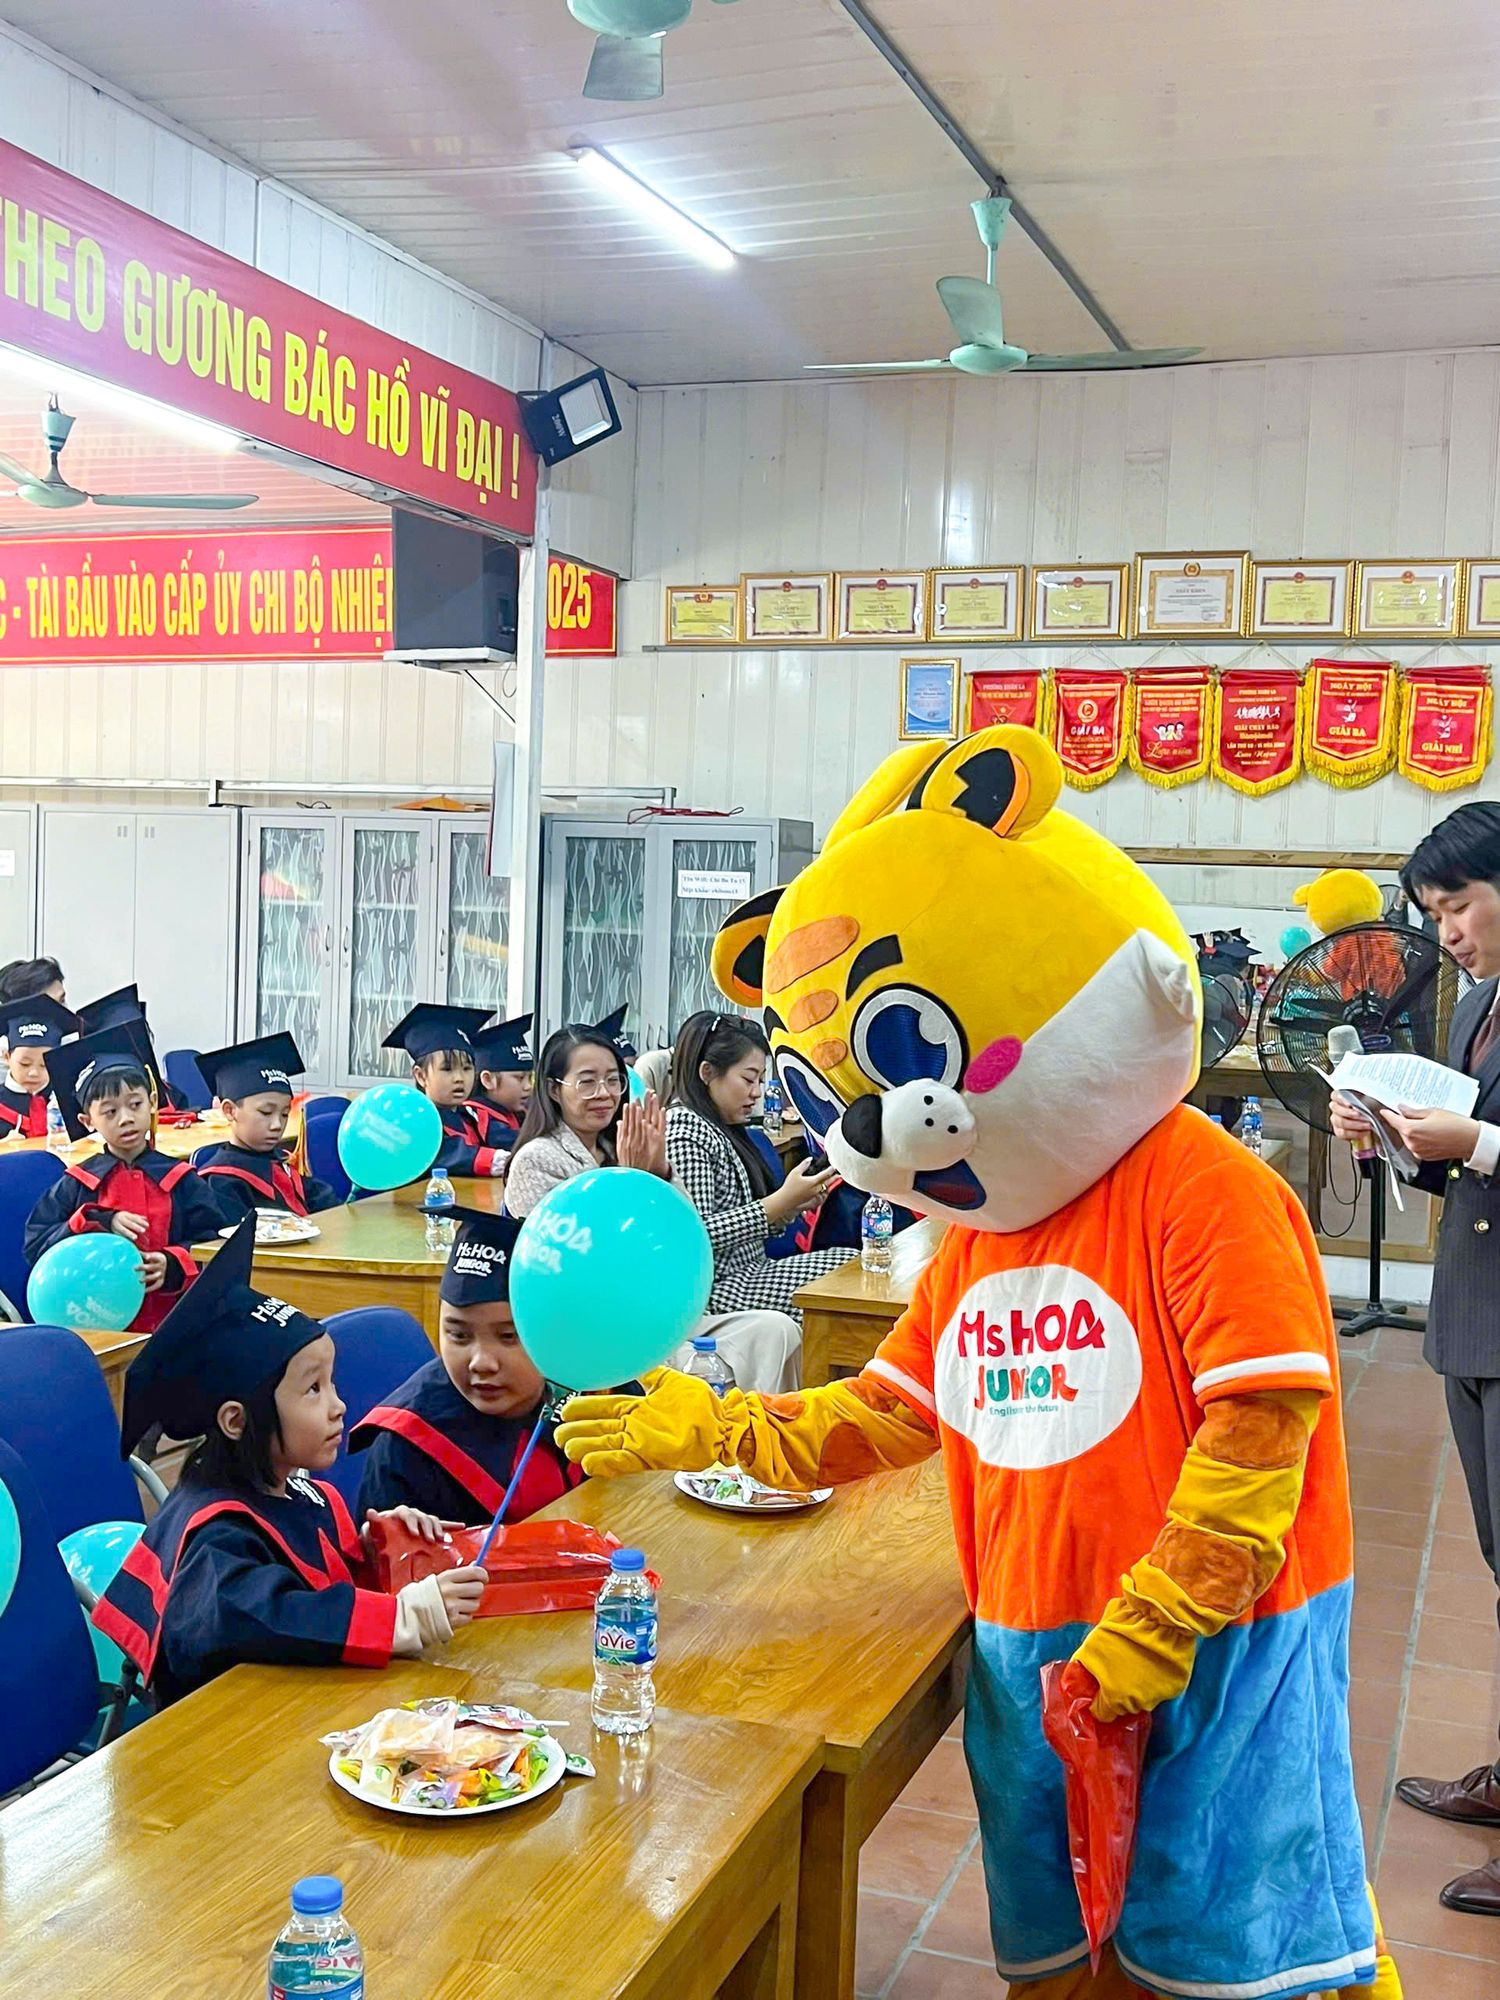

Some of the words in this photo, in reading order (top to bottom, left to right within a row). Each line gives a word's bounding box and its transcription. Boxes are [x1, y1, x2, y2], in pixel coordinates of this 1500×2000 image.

[0, 196, 105, 332] HEO
[123, 259, 271, 404] GƯƠNG
[284, 329, 356, 436] BÁC
[367, 357, 411, 457] HỒ
[419, 385, 450, 473] VĨ
[456, 408, 502, 505] ĐẠI
[26, 562, 60, 639] TÀI
[65, 552, 110, 638] BẦU
[114, 560, 158, 637] VÀO
[163, 549, 208, 637] CẤP
[214, 549, 243, 636] ỦY
[250, 569, 287, 636] CHI
[293, 555, 325, 649] BỘ
